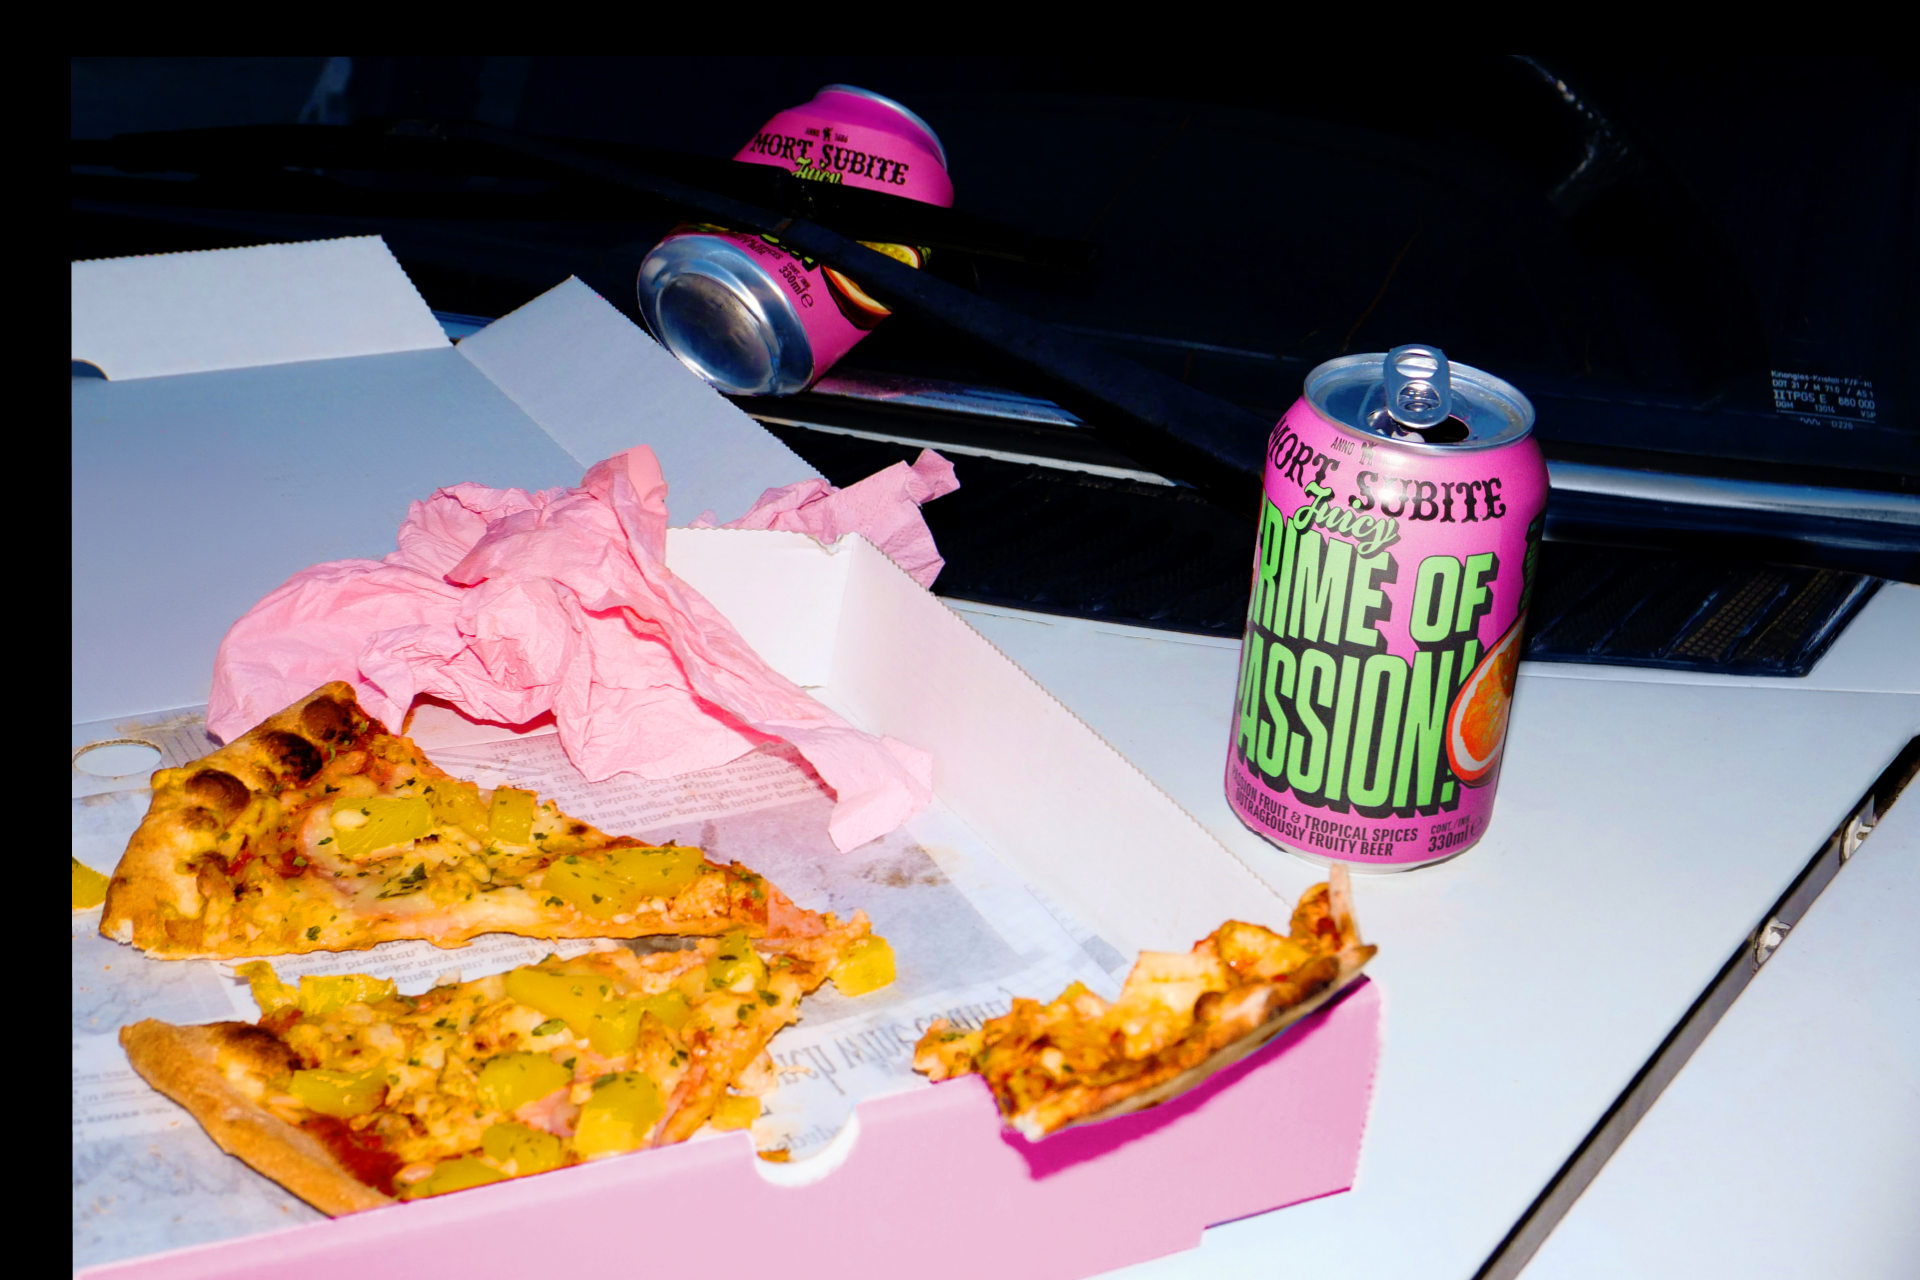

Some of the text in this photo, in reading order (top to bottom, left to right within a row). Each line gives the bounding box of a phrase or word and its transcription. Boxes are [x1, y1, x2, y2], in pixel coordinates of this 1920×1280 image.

[749, 133, 909, 186] MORT SUBITE
[778, 266, 806, 296] 330ml
[1819, 393, 1827, 404] E
[1268, 416, 1507, 524] MORT SUBITE
[1330, 436, 1355, 455] ANNO
[1293, 481, 1401, 555] Juicy
[1253, 490, 1491, 648] RIME OF
[1237, 630, 1479, 809] ASSION!
[1236, 787, 1394, 857] OUTRAGEOUSLY FRUITY BEER
[1259, 791, 1289, 820] FRUIT
[1291, 810, 1302, 824] &
[1304, 813, 1368, 842] TROPICAL
[1372, 827, 1418, 843] SPICES
[1427, 824, 1469, 853] 330ml
